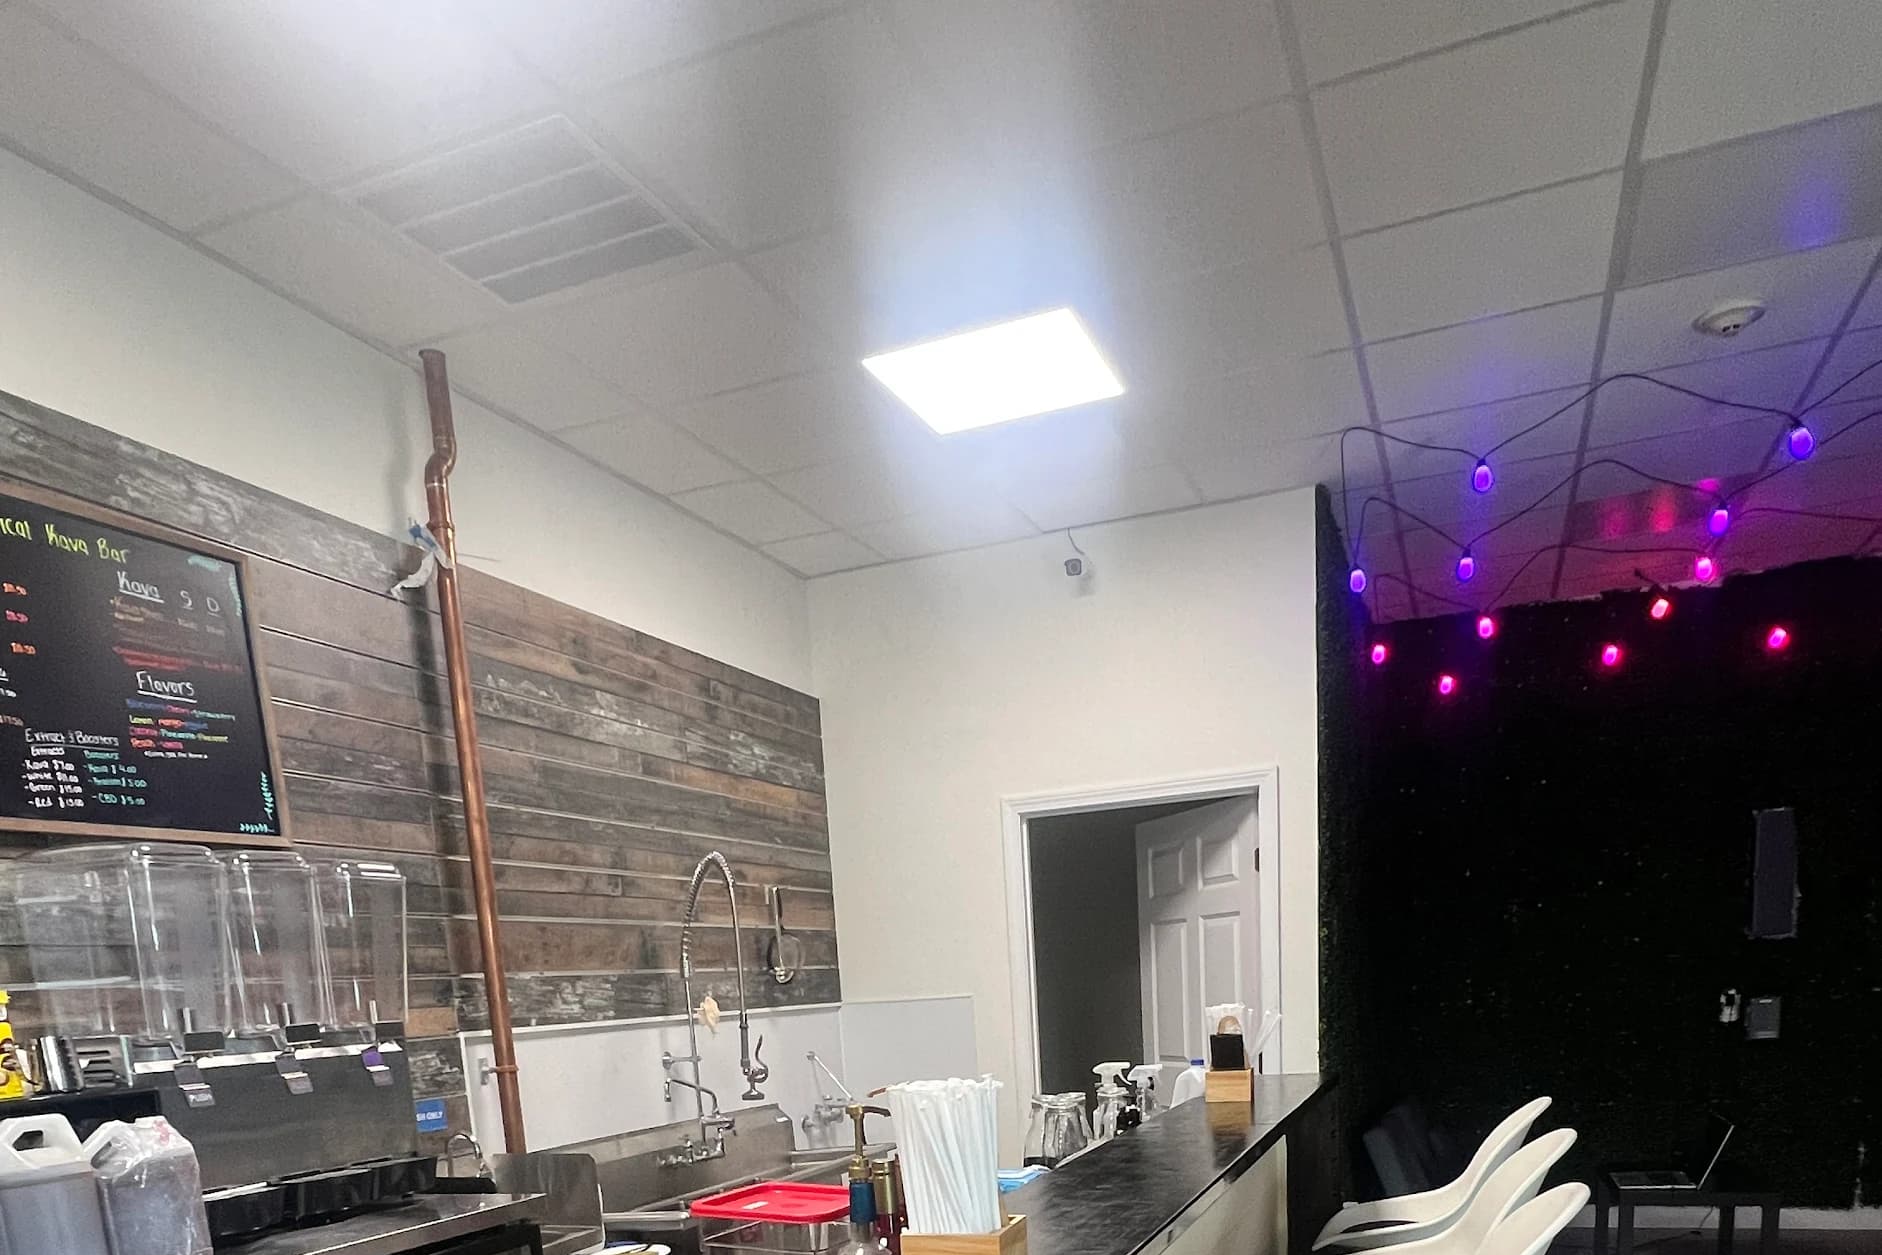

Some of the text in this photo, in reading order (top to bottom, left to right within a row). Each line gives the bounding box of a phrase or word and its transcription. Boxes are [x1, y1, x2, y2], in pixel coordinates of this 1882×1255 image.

[45, 523, 90, 556] Kava
[97, 537, 131, 563] Bar
[117, 570, 161, 599] Kava
[136, 670, 196, 696] Flavors
